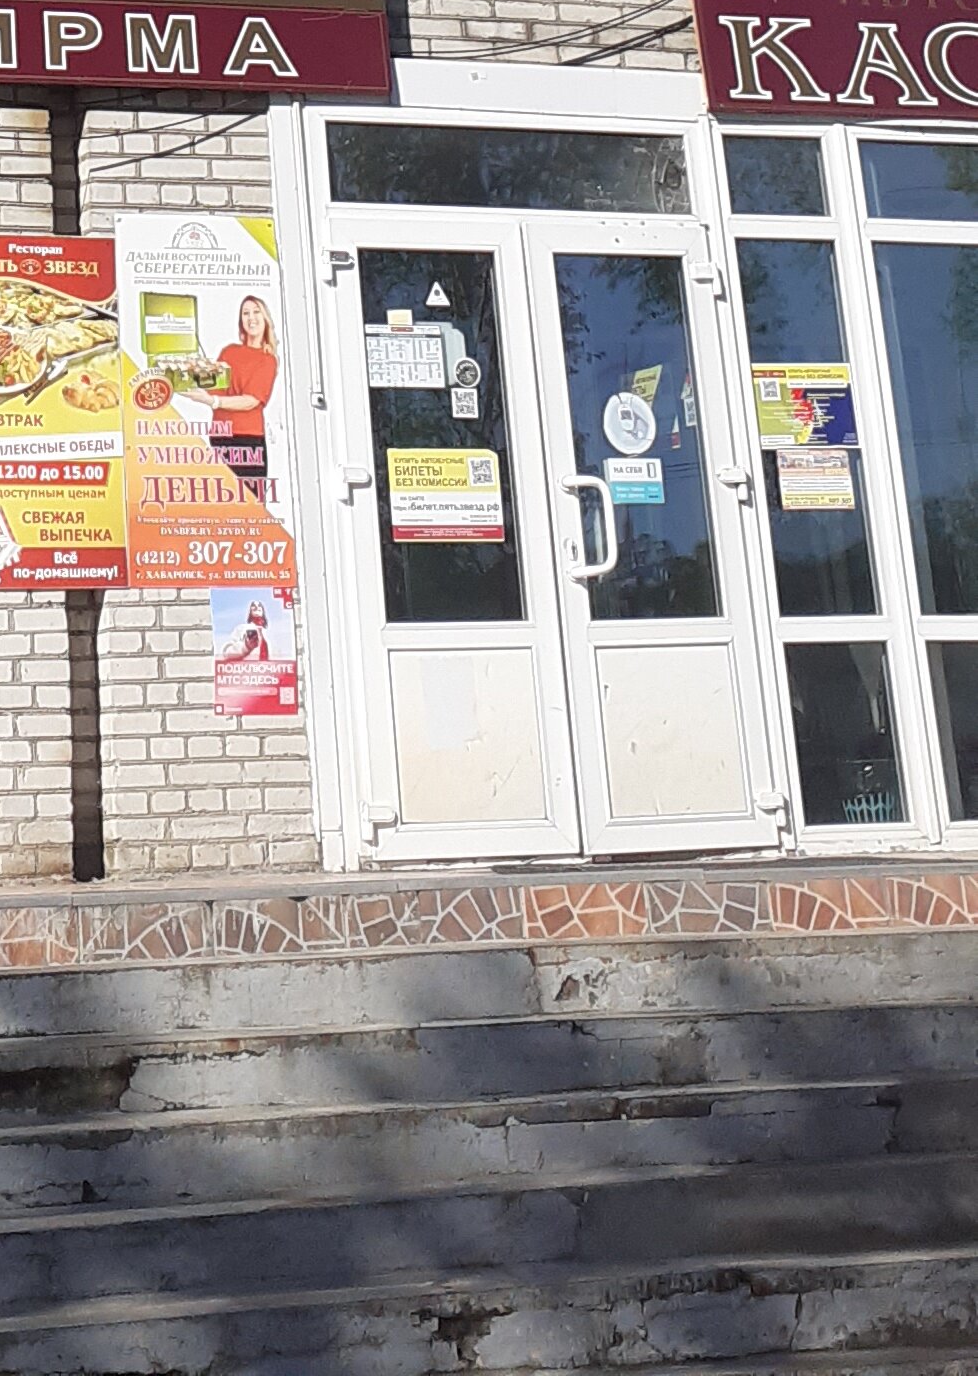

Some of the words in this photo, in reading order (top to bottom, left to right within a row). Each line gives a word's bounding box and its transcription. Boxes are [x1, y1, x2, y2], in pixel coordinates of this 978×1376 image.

[8, 243, 63, 256] Ресторан
[125, 251, 242, 263] ДАЛЬНЕВОСТОЧНЫЙ
[43, 260, 100, 278] ЗВЕЗД
[133, 262, 271, 276] СБЕРЕГАТЕЛЬНЫЙ
[137, 420, 233, 436] НАКОПИМ
[69, 439, 115, 453] ОБЕДЫ
[137, 446, 265, 465] УМНОЖИМ
[40, 468, 60, 481] до
[63, 466, 104, 480] 15.00
[394, 466, 443, 476] БИЛЕТЫ
[395, 478, 413, 487] БЕЗ
[416, 477, 468, 487] КОМИССИИ
[68, 489, 106, 499] ценам
[139, 476, 281, 511] ДЕНЬГИ
[22, 511, 85, 524] СВЕЖАЯ
[40, 529, 113, 542] ВЫПЕЧКА
[53, 551, 78, 564] Всё
[135, 550, 181, 566] (4212)
[188, 540, 288, 565] 307-307
[13, 565, 119, 580] по-домашнему!
[217, 663, 294, 673] ПОДКЛЮЧИТЕ
[217, 675, 241, 685] МТС
[242, 675, 279, 685] ЗДЕСЬ
